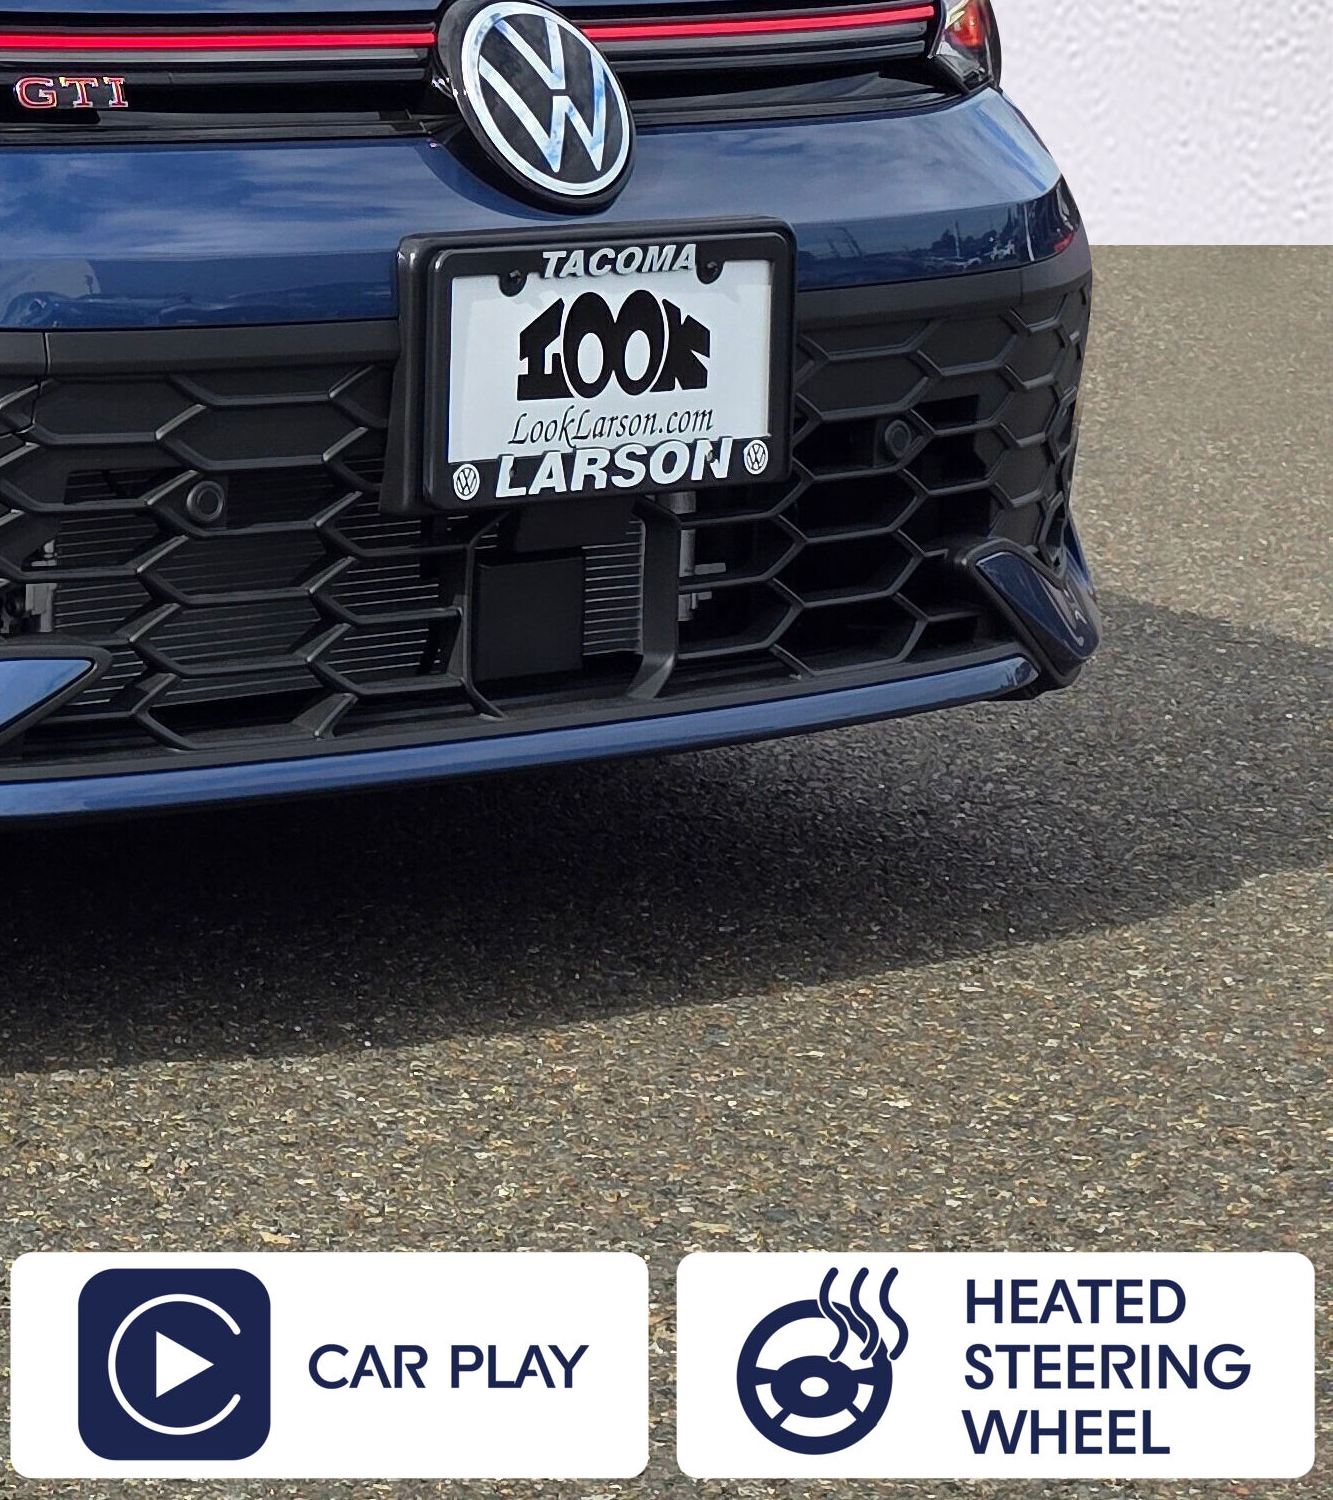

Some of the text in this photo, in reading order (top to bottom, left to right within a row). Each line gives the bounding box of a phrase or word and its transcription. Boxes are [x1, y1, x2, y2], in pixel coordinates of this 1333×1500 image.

[13, 76, 129, 109] GTI
[542, 243, 698, 280] TACOMA
[516, 288, 712, 402] LOOK
[507, 404, 715, 448] LookLarson.com
[495, 436, 734, 498] LARSON
